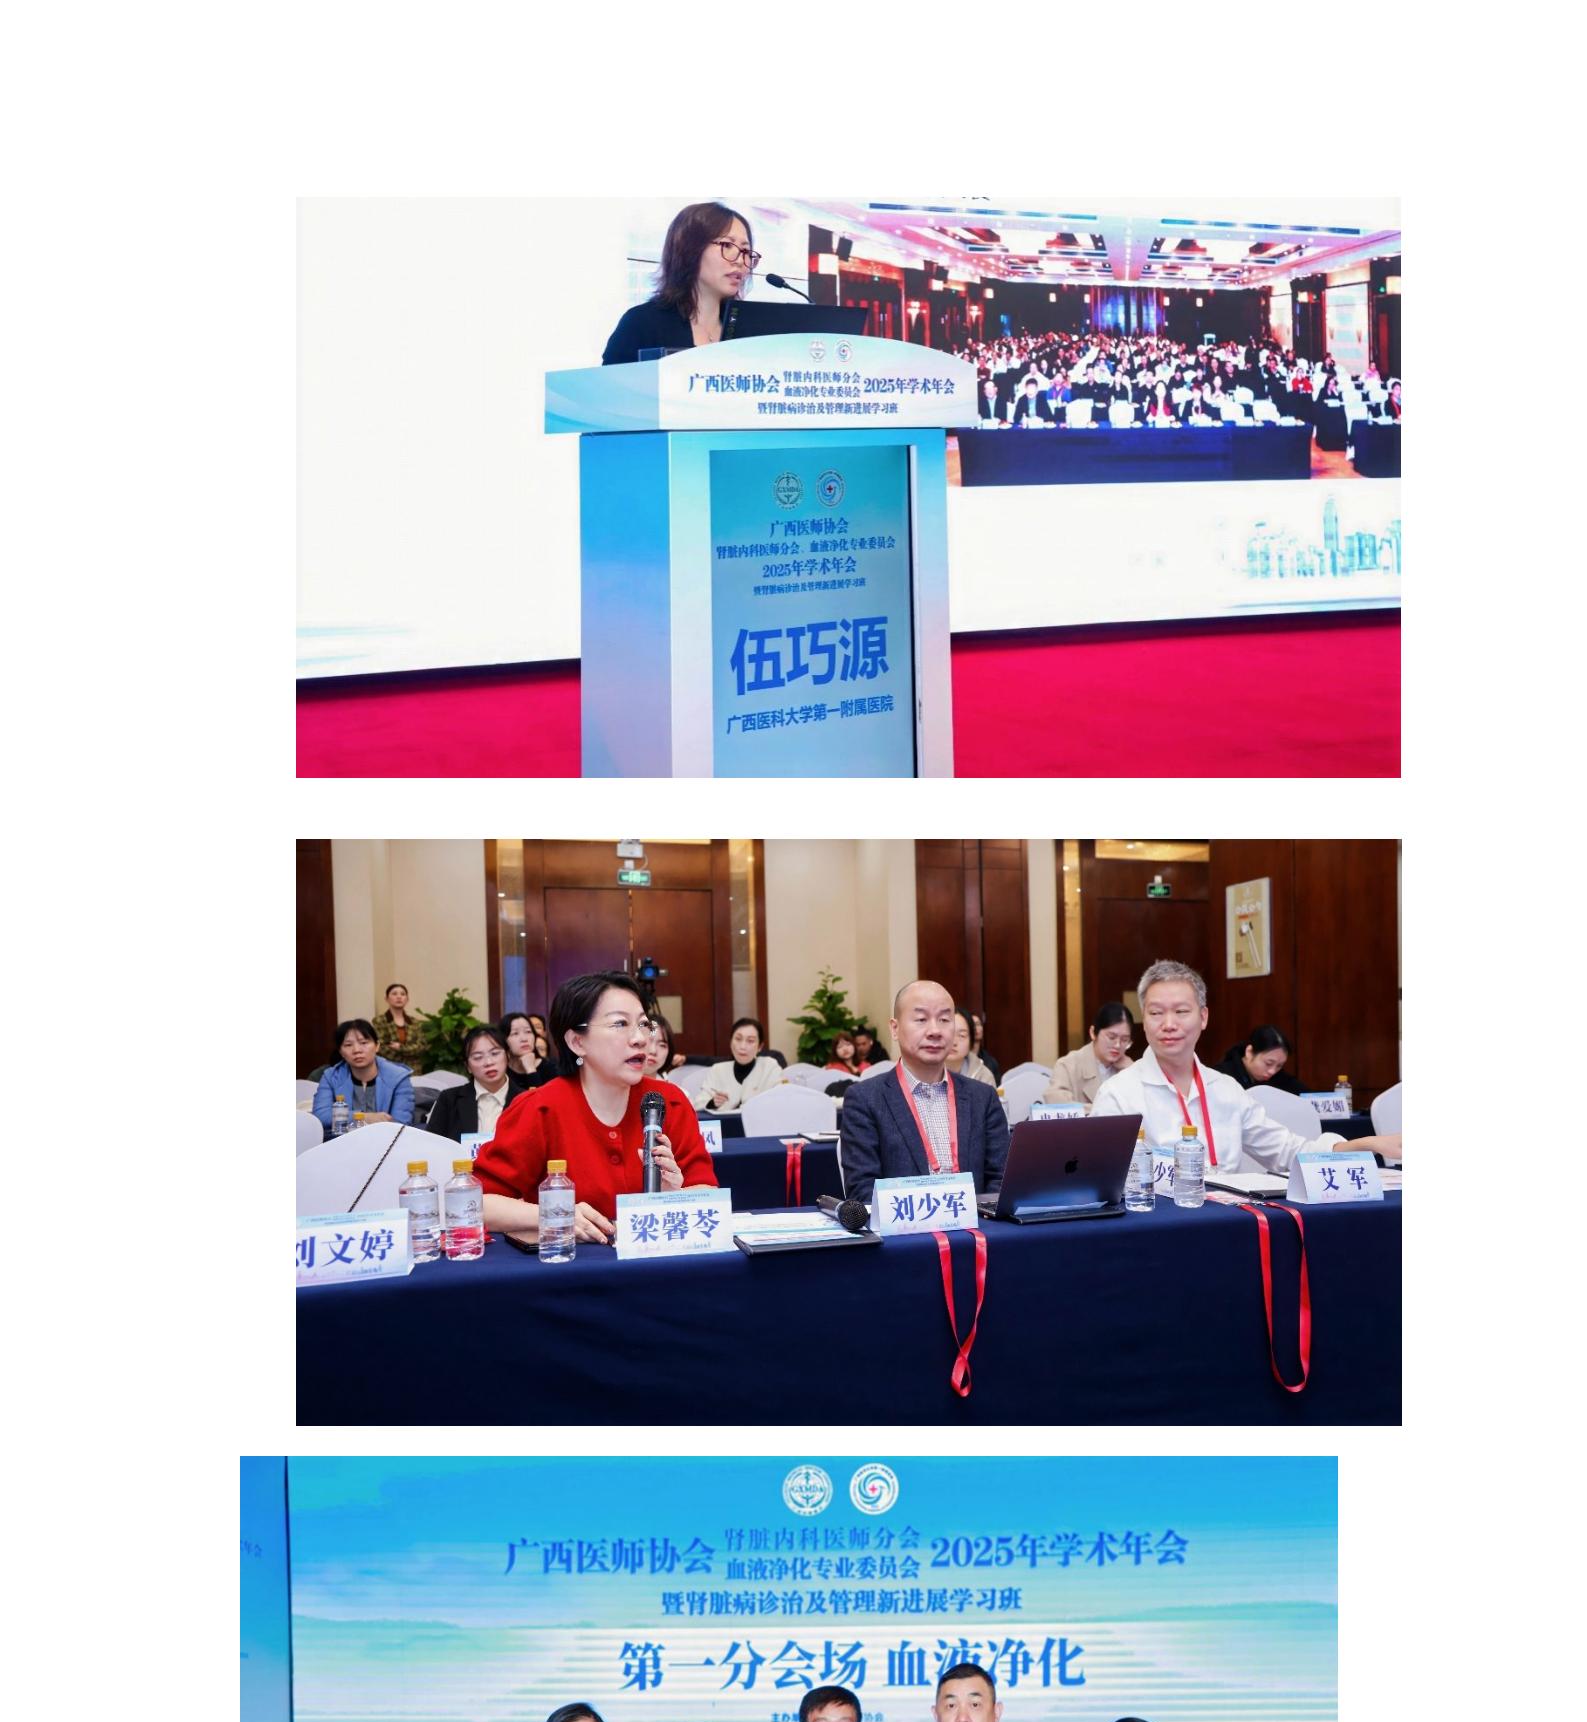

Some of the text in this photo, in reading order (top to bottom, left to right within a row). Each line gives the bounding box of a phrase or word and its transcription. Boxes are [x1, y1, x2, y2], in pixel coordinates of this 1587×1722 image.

[688, 373, 780, 394] 广西医师协会
[783, 370, 861, 384] 肾脏内科医师分会
[863, 377, 955, 394] 2025年学术年会
[784, 385, 861, 398] 血液净化专业委员会
[769, 516, 849, 538] 广西医师协会
[762, 556, 857, 579] 2025年学术年会
[729, 616, 889, 696] 伍巧源
[726, 694, 895, 735] 广西医科大学第一附属医院
[1317, 1166, 1369, 1191] 艾军
[891, 1189, 967, 1224] 刘少军
[630, 1208, 720, 1243] 梁馨苓
[296, 1228, 394, 1268] 刘文婷
[724, 1525, 921, 1552] 肾脏内科医师分会
[929, 1528, 1190, 1569] 2025年学术年会
[504, 1536, 716, 1575] 广西医师协会
[725, 1554, 921, 1581] 血液净化专业委员会
[661, 1587, 1023, 1617] 暨肾脏病诊治及管理新进展学习班
[618, 1637, 1087, 1691] 第一分会场 血液净化
